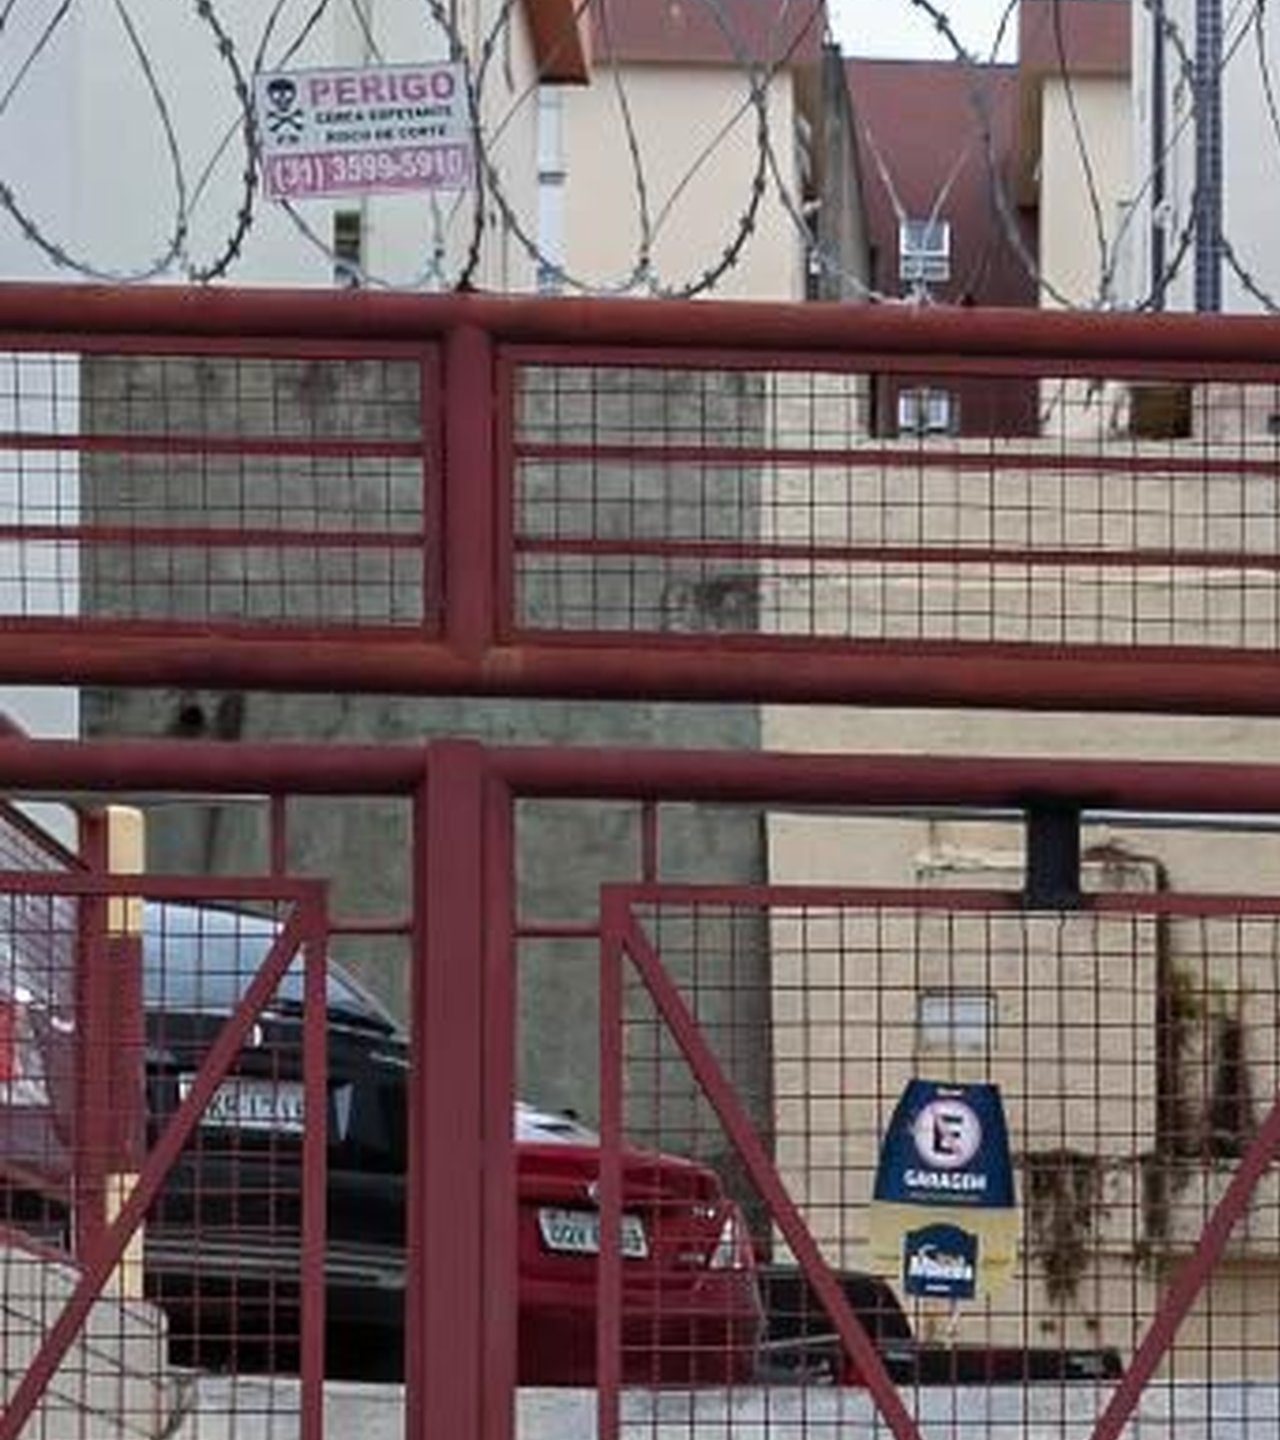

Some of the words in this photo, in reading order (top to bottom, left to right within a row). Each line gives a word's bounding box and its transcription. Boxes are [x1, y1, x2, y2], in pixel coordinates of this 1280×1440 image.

[309, 70, 456, 107] PERIGO
[932, 1114, 964, 1155] E
[903, 1168, 988, 1191] GARAGEM
